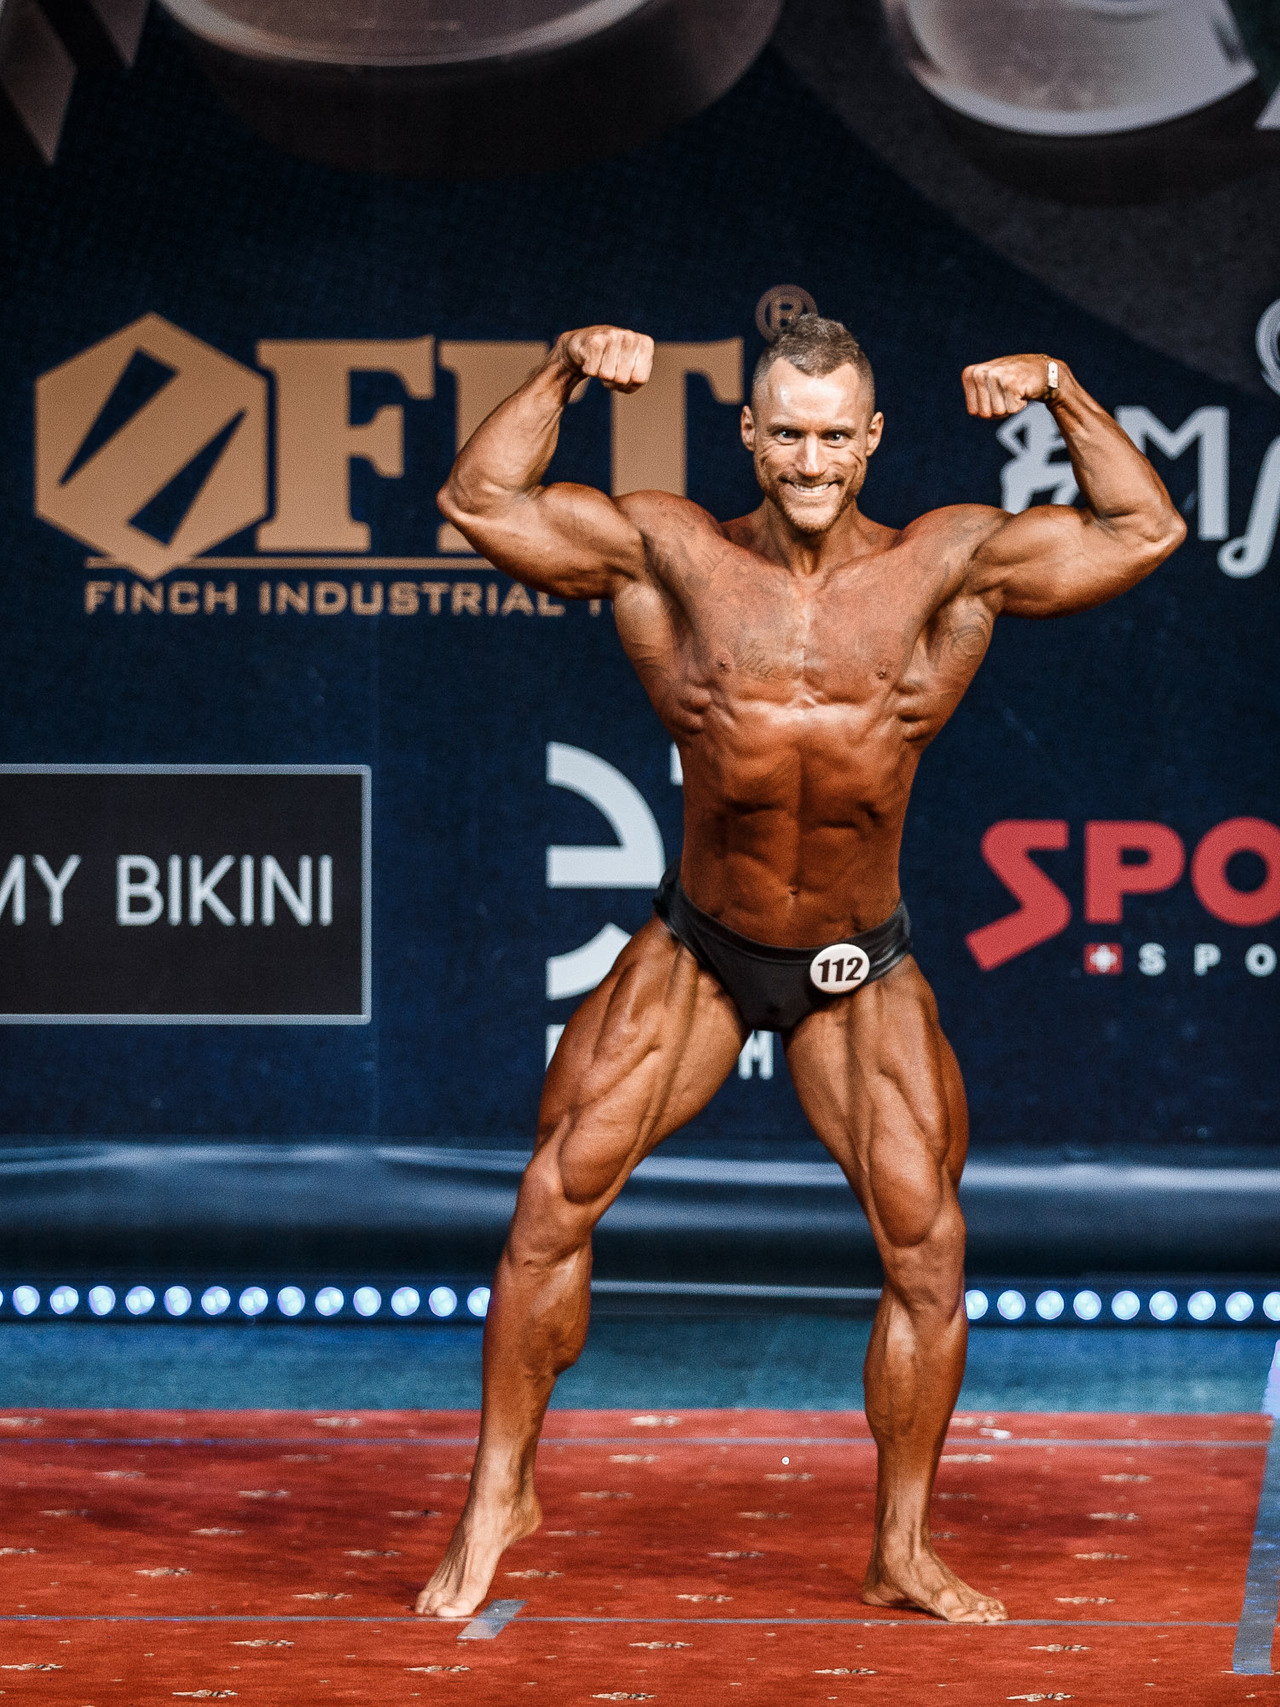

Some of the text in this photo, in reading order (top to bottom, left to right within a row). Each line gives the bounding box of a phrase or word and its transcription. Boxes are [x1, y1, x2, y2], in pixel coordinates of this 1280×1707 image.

[86, 581, 238, 615] FINCH
[259, 581, 566, 616] INDUSTRIAL
[116, 854, 333, 927] BIKINI
[818, 957, 863, 983] 112
